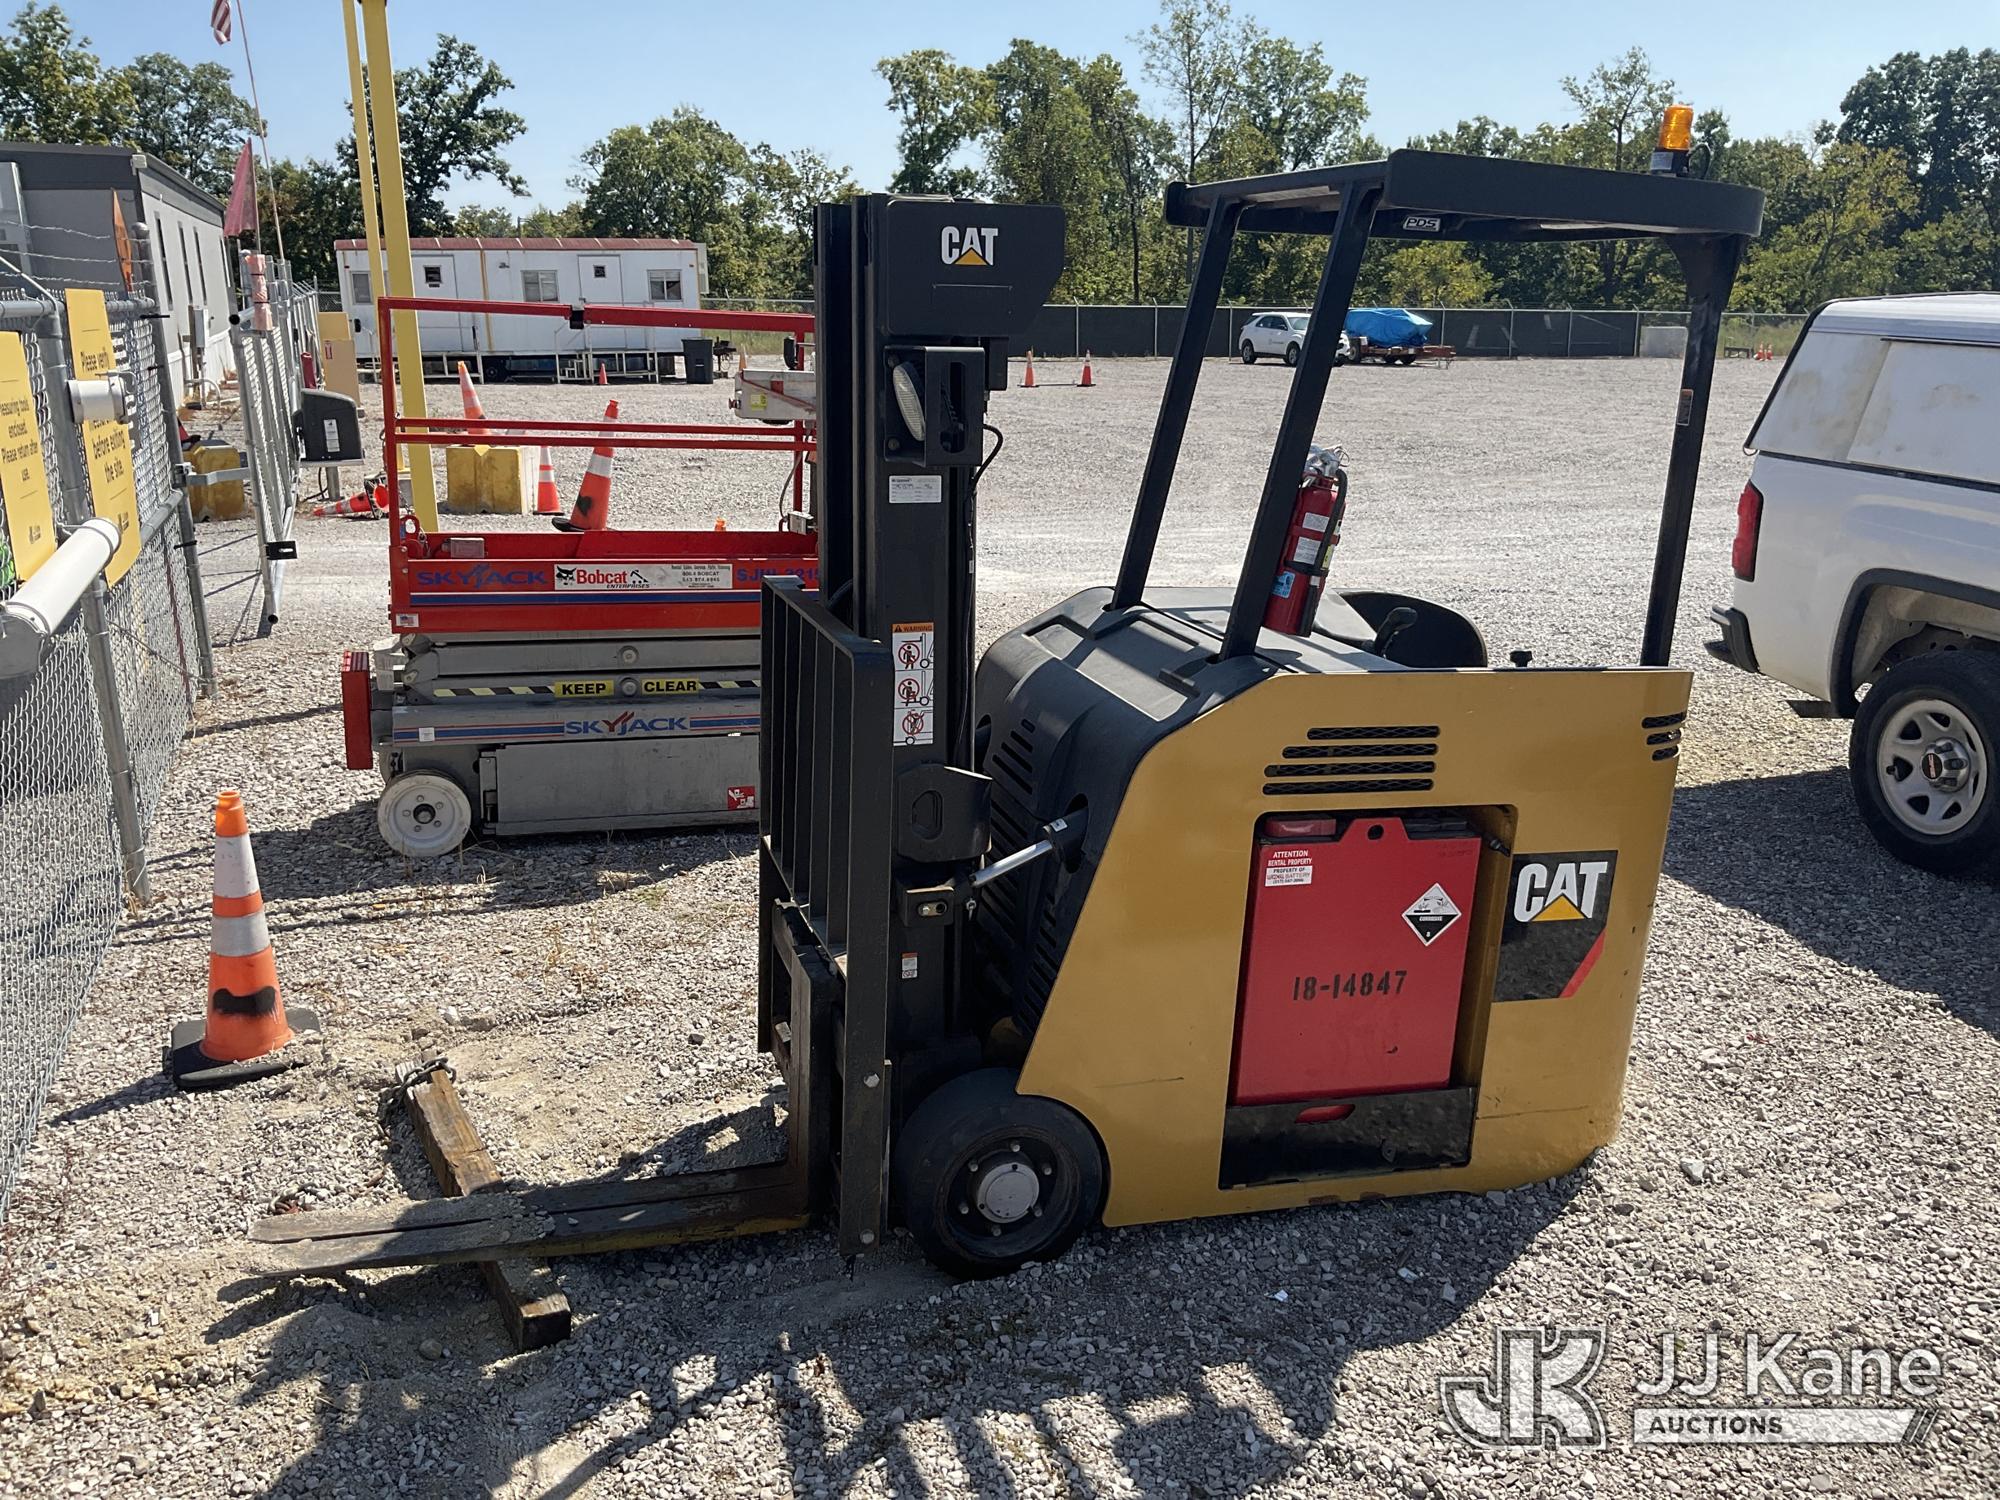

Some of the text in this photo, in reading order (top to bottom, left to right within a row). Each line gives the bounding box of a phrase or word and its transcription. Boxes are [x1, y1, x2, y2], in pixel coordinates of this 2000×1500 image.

[1406, 218, 1438, 228] PDS
[941, 226, 998, 266] CAT
[80, 351, 98, 372] Please
[92, 434, 111, 460] before
[104, 461, 115, 484] the
[417, 563, 548, 589] SKYJACK
[576, 569, 627, 584] Bobcat
[562, 680, 697, 695] KEEP CLEAR
[566, 711, 688, 736] SKYJACK
[1273, 850, 1308, 858] ATTENTION
[1288, 858, 1312, 866] PROPERTY
[1513, 861, 1609, 923] CAT
[1293, 970, 1408, 1001] 18-14847
